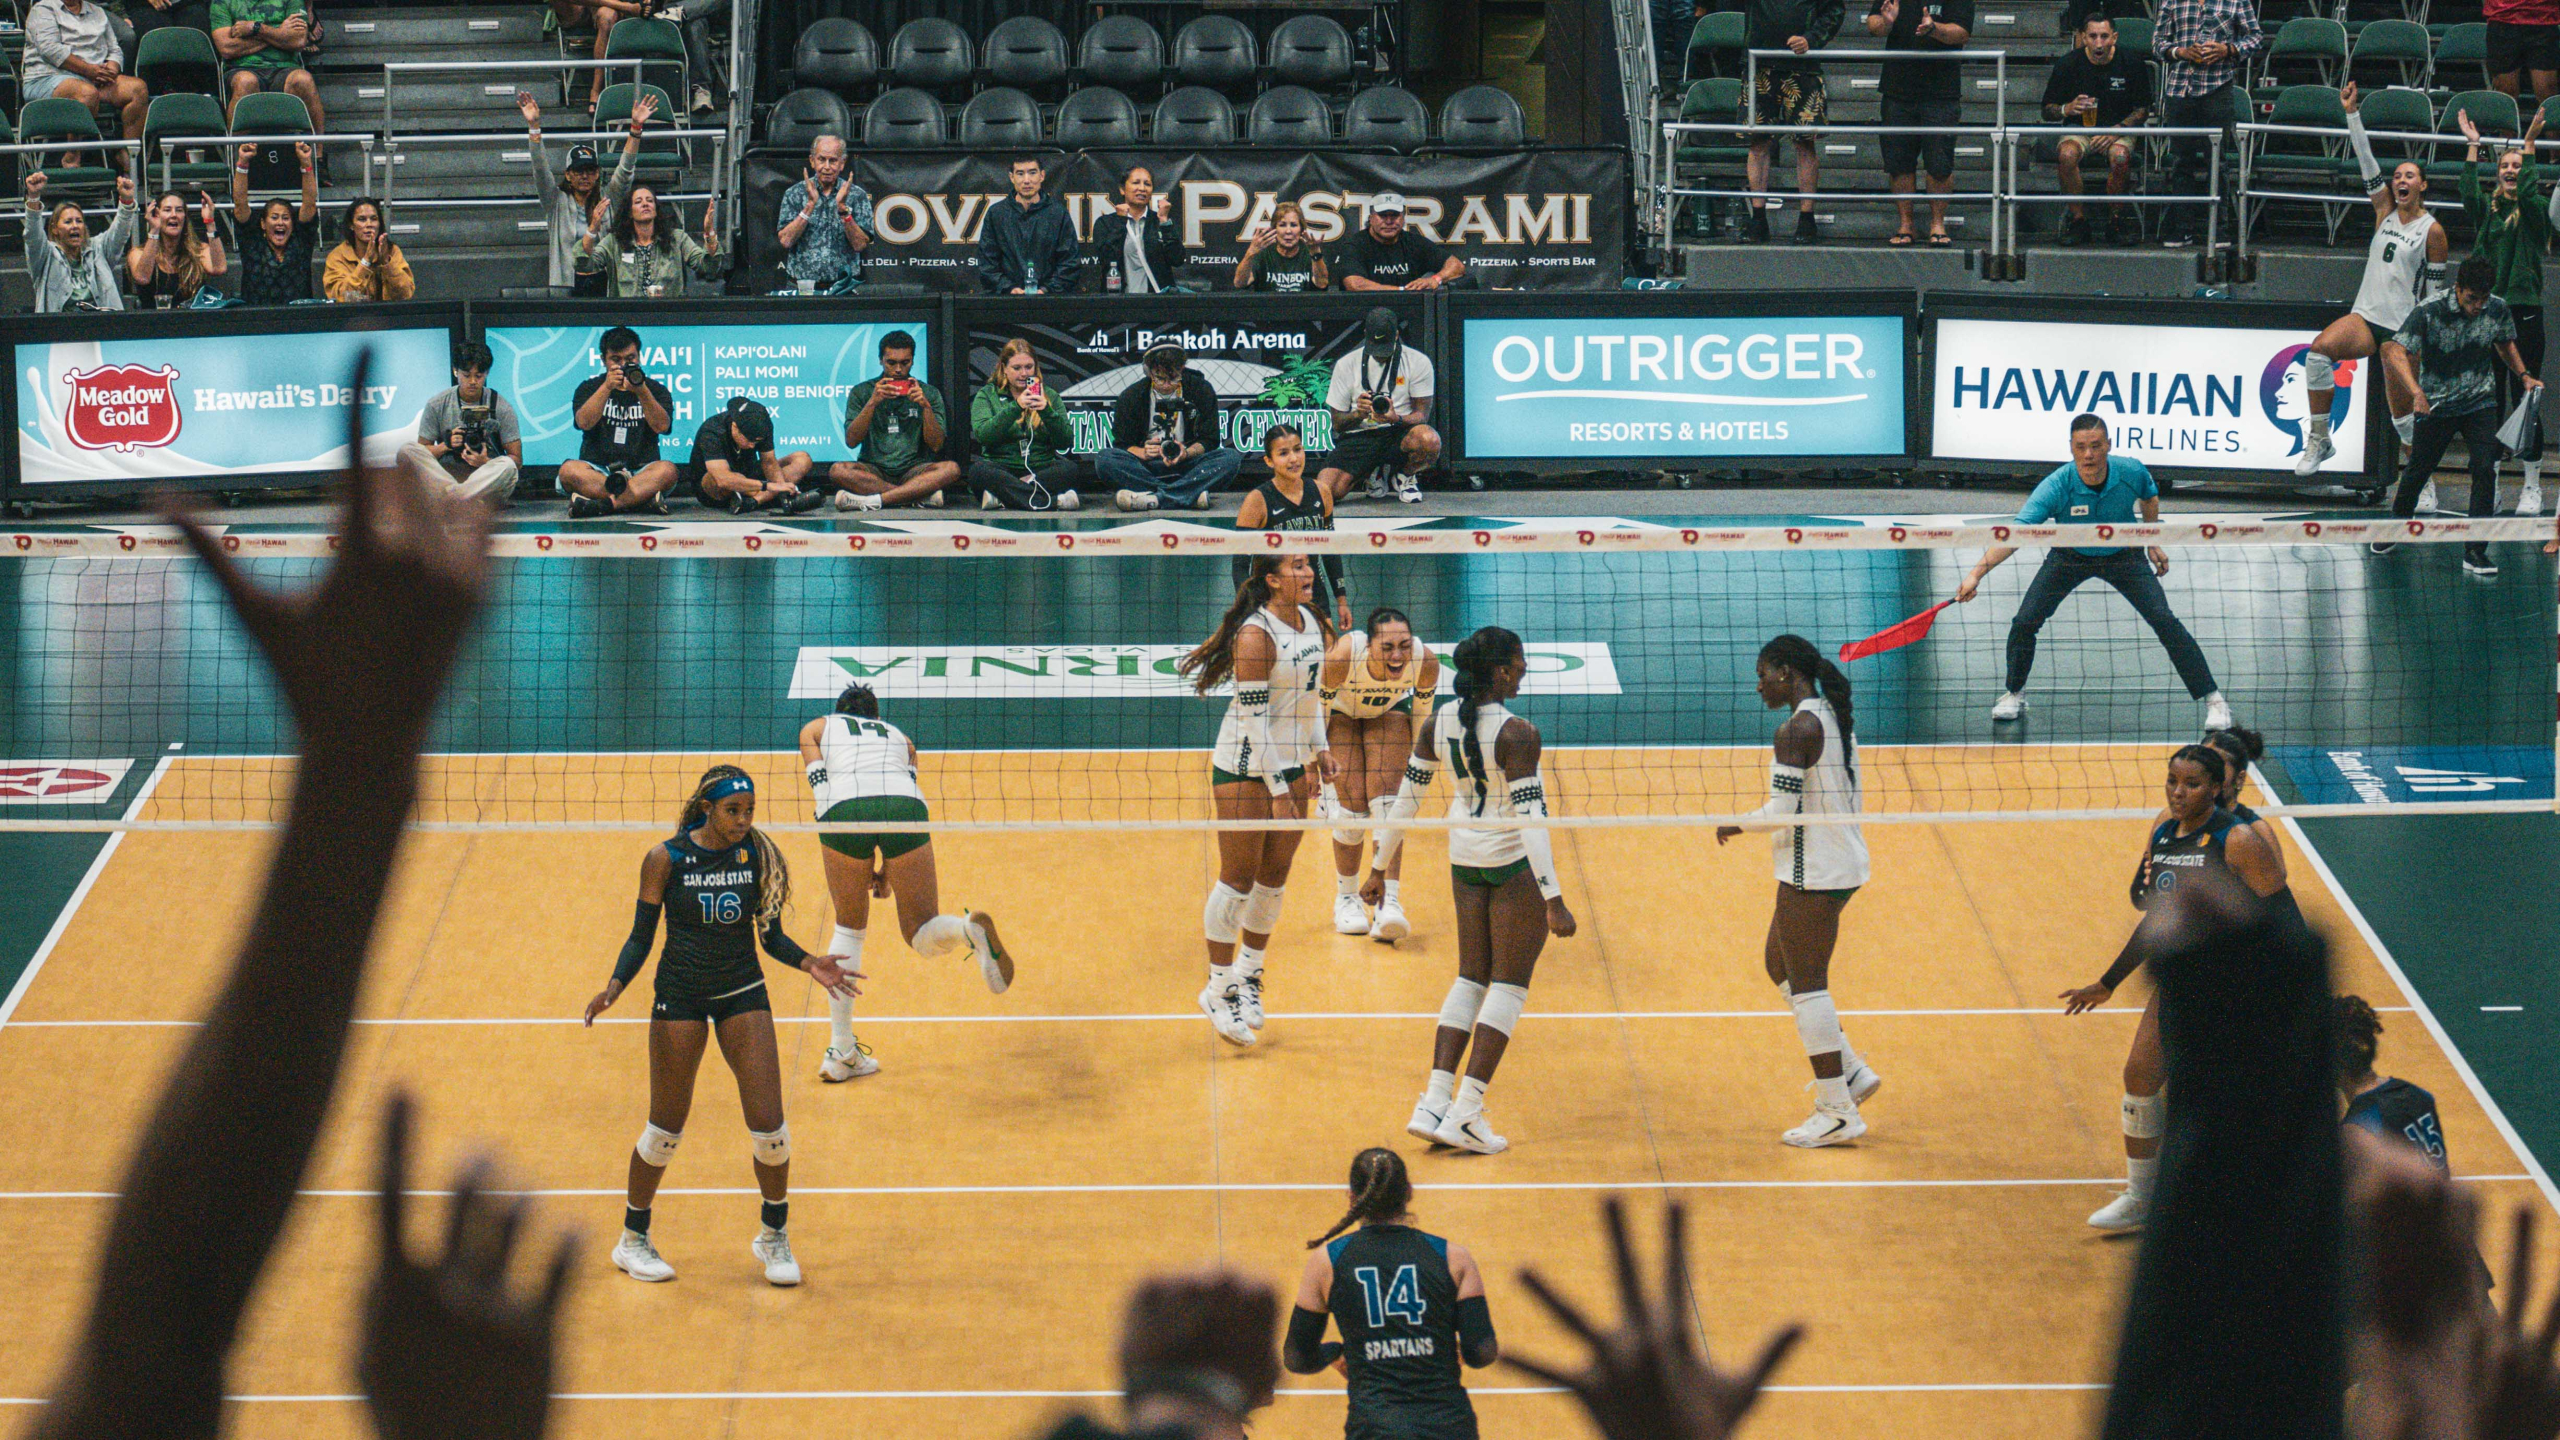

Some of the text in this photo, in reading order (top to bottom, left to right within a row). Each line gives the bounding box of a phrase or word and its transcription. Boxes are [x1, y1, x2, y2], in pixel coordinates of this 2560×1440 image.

[2382, 241, 2397, 263] 6
[1232, 330, 1306, 349] Arena
[715, 366, 798, 378] PALI MOMI
[79, 385, 166, 407] Meadow
[193, 384, 398, 412] Hawaii's Dary
[715, 386, 779, 399] STRAUB
[1953, 366, 2242, 418] HAWAIIAN
[98, 406, 150, 427] Gold
[1570, 421, 1789, 442] RESORTS & HOTELS
[2115, 426, 2241, 453] IRLINES
[1361, 696, 1391, 706] 10
[840, 716, 889, 739] 14
[683, 869, 753, 887] SAN JOSÉ STATE
[698, 891, 742, 924] 16
[1354, 1264, 1427, 1328] 14
[1364, 1337, 1434, 1361] SPARTANS
